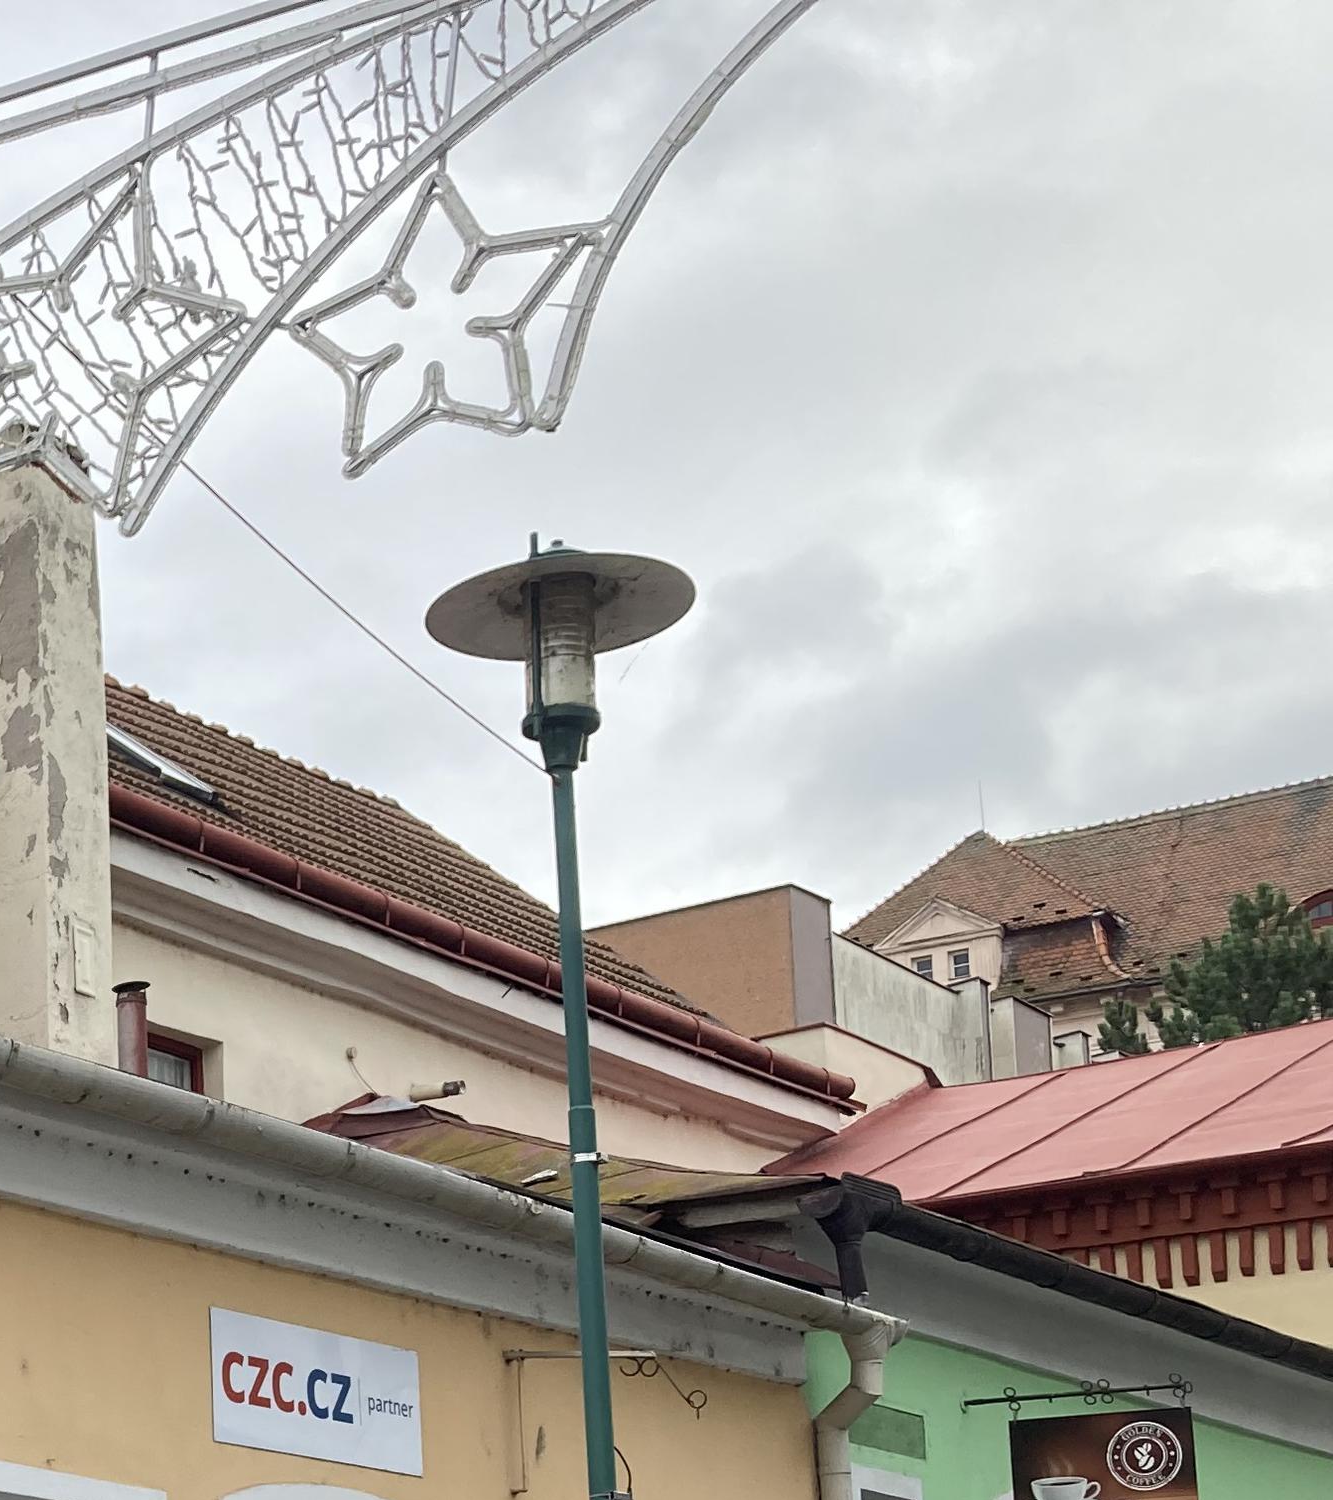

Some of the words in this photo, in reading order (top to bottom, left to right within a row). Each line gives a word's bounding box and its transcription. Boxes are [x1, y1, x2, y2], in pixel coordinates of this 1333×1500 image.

[221, 1351, 354, 1425] CZC.CZ
[367, 1396, 414, 1419] partner
[1121, 1426, 1163, 1441] GOLDEN
[1126, 1473, 1166, 1486] COFFEE
